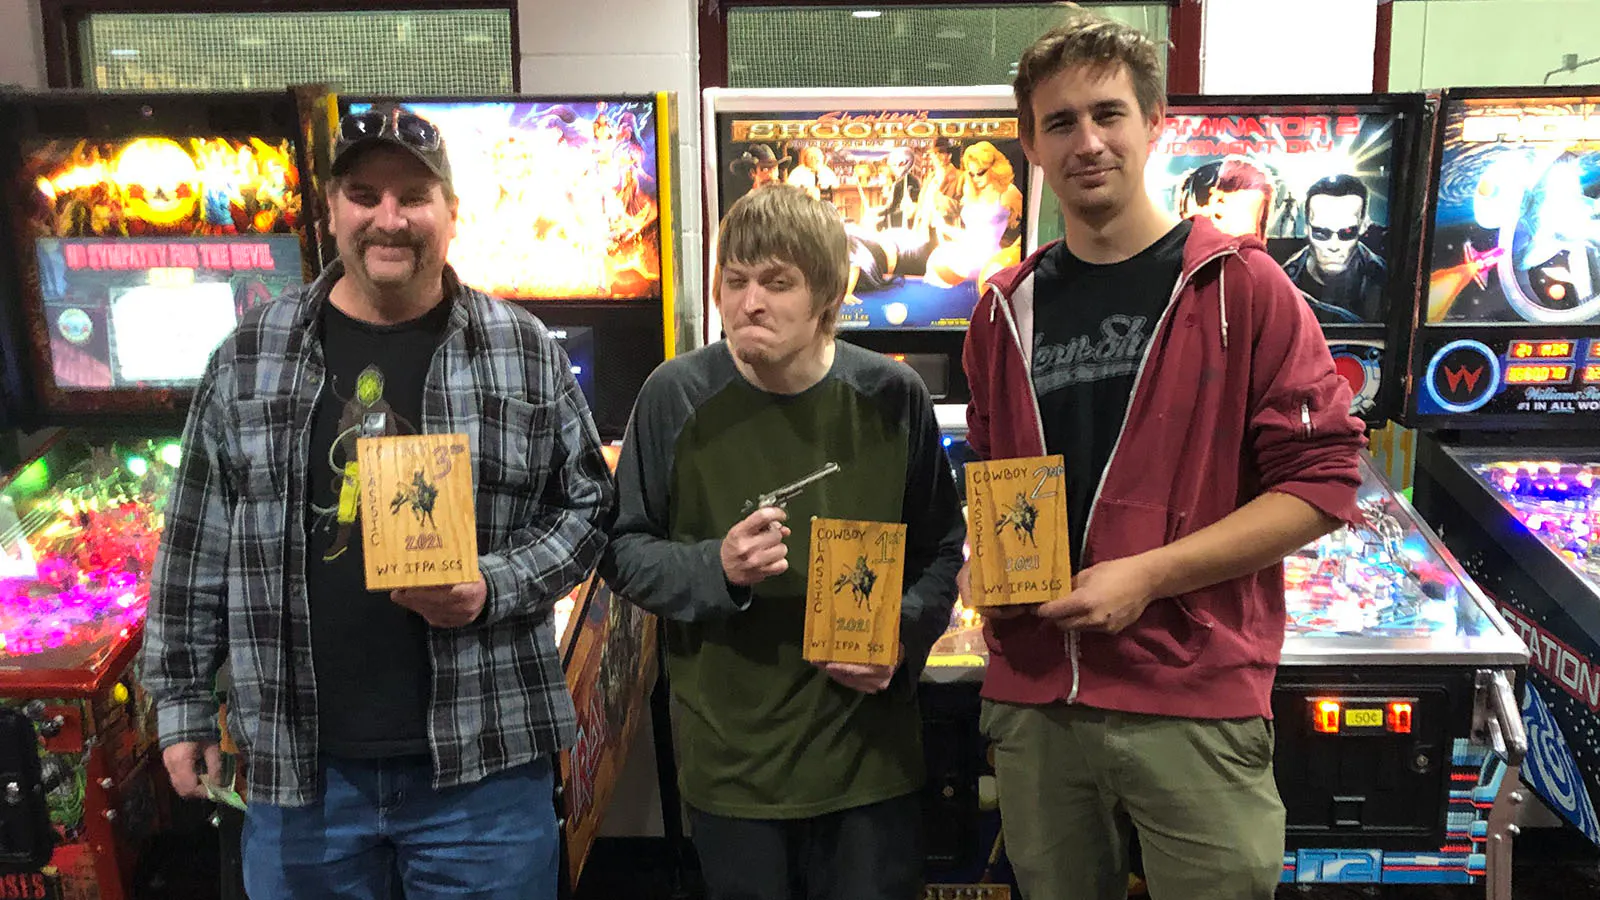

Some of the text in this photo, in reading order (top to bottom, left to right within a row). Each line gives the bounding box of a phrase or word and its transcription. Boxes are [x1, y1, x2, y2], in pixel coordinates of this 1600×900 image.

[817, 110, 929, 129] Sharkey's
[1164, 116, 1360, 138] RMINATOR 2
[749, 121, 1000, 138] SHOOTOUT
[1165, 140, 1333, 156] DGMENT DAY
[1534, 402, 1547, 410] IN
[1550, 402, 1575, 411] ALL
[973, 467, 1028, 484] COWBOY
[405, 532, 443, 551] 2021
[817, 527, 866, 541] COWBOY
[377, 560, 463, 576] WY IFPA SCS
[1005, 556, 1040, 572] 2021
[983, 579, 1062, 594] WY IFPA SCS
[836, 617, 871, 633] 2021
[835, 642, 861, 651] IFPA
[867, 644, 885, 653] SCS
